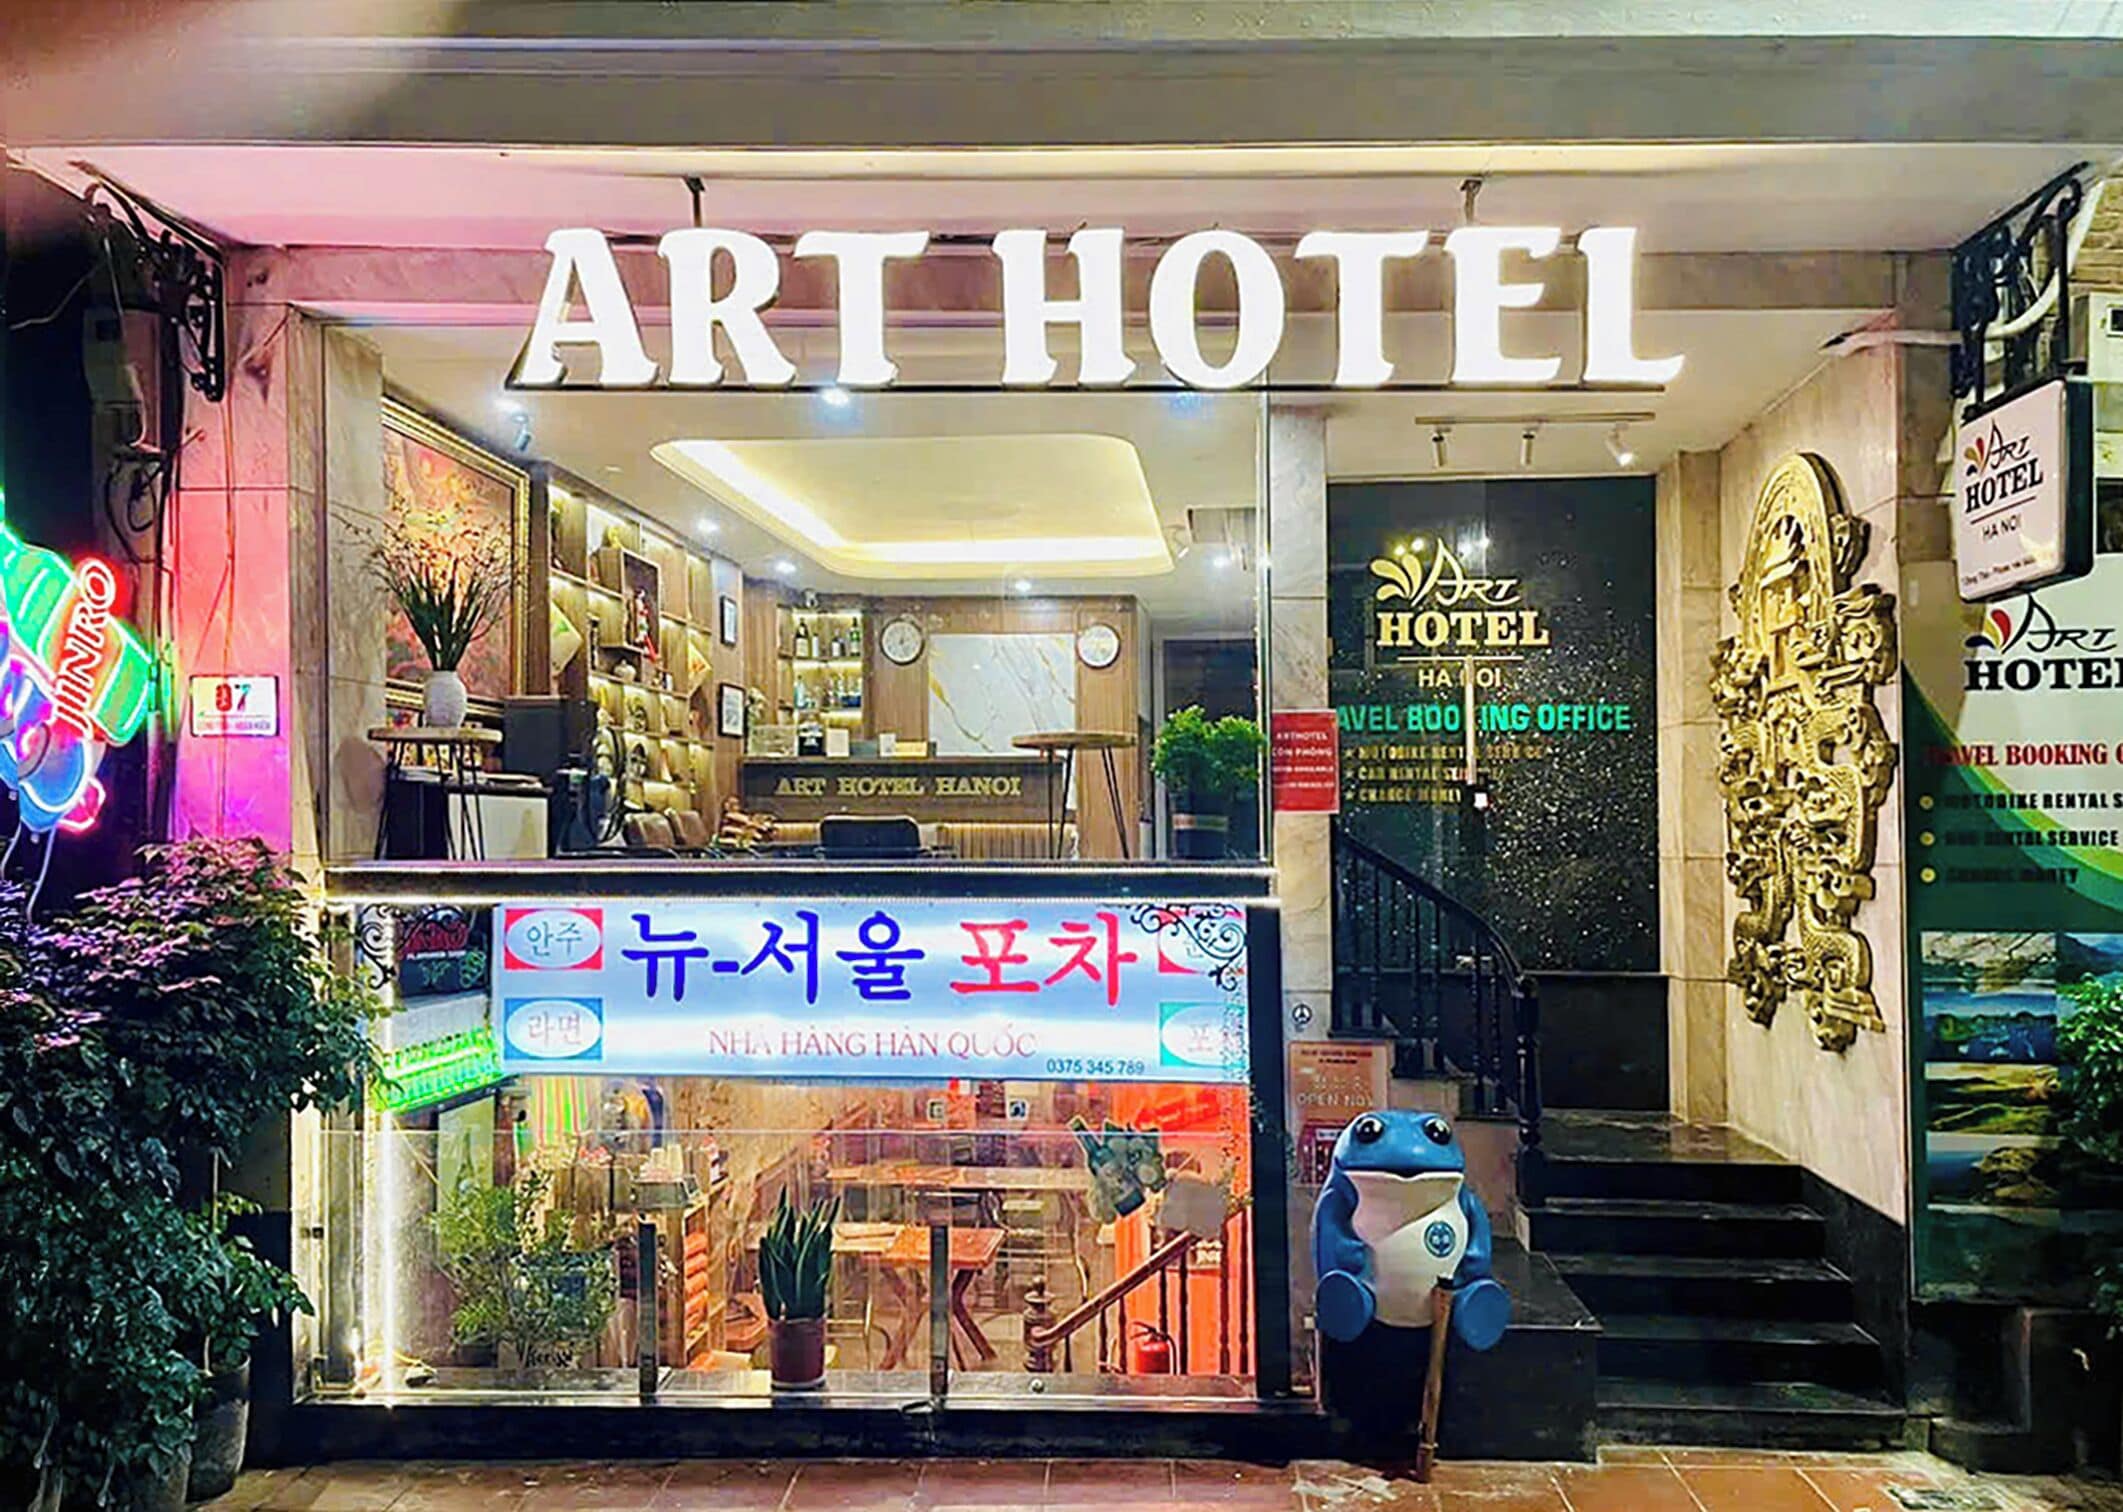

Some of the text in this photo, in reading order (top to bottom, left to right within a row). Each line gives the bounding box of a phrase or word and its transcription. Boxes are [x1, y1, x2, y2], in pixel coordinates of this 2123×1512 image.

[519, 227, 1685, 389] ART HOTEL
[1980, 417, 2030, 475] ART
[1965, 458, 2044, 513] HOTEL
[1411, 538, 1520, 606] ART
[1376, 611, 1549, 647] HOTEL
[2001, 592, 2117, 654] ART
[52, 557, 116, 740] JINRO
[1964, 657, 2123, 690] HOTE
[1338, 703, 1631, 731] AVEL BOOING OFFICE
[2006, 743, 2107, 766] BOOKING
[776, 777, 1021, 796] ART HOTEL HANOI
[2044, 792, 2109, 808] RENTAL
[2048, 831, 2119, 846] SERVICE
[526, 921, 582, 957] 안주
[621, 910, 1138, 1007] 뉴-서울 포차
[527, 1011, 582, 1046] 라면
[781, 1025, 867, 1057] HÀNG
[875, 1025, 938, 1057] HÀN
[948, 1023, 1037, 1058] QUỐC
[1046, 1058, 1145, 1076] 0375 345 789
